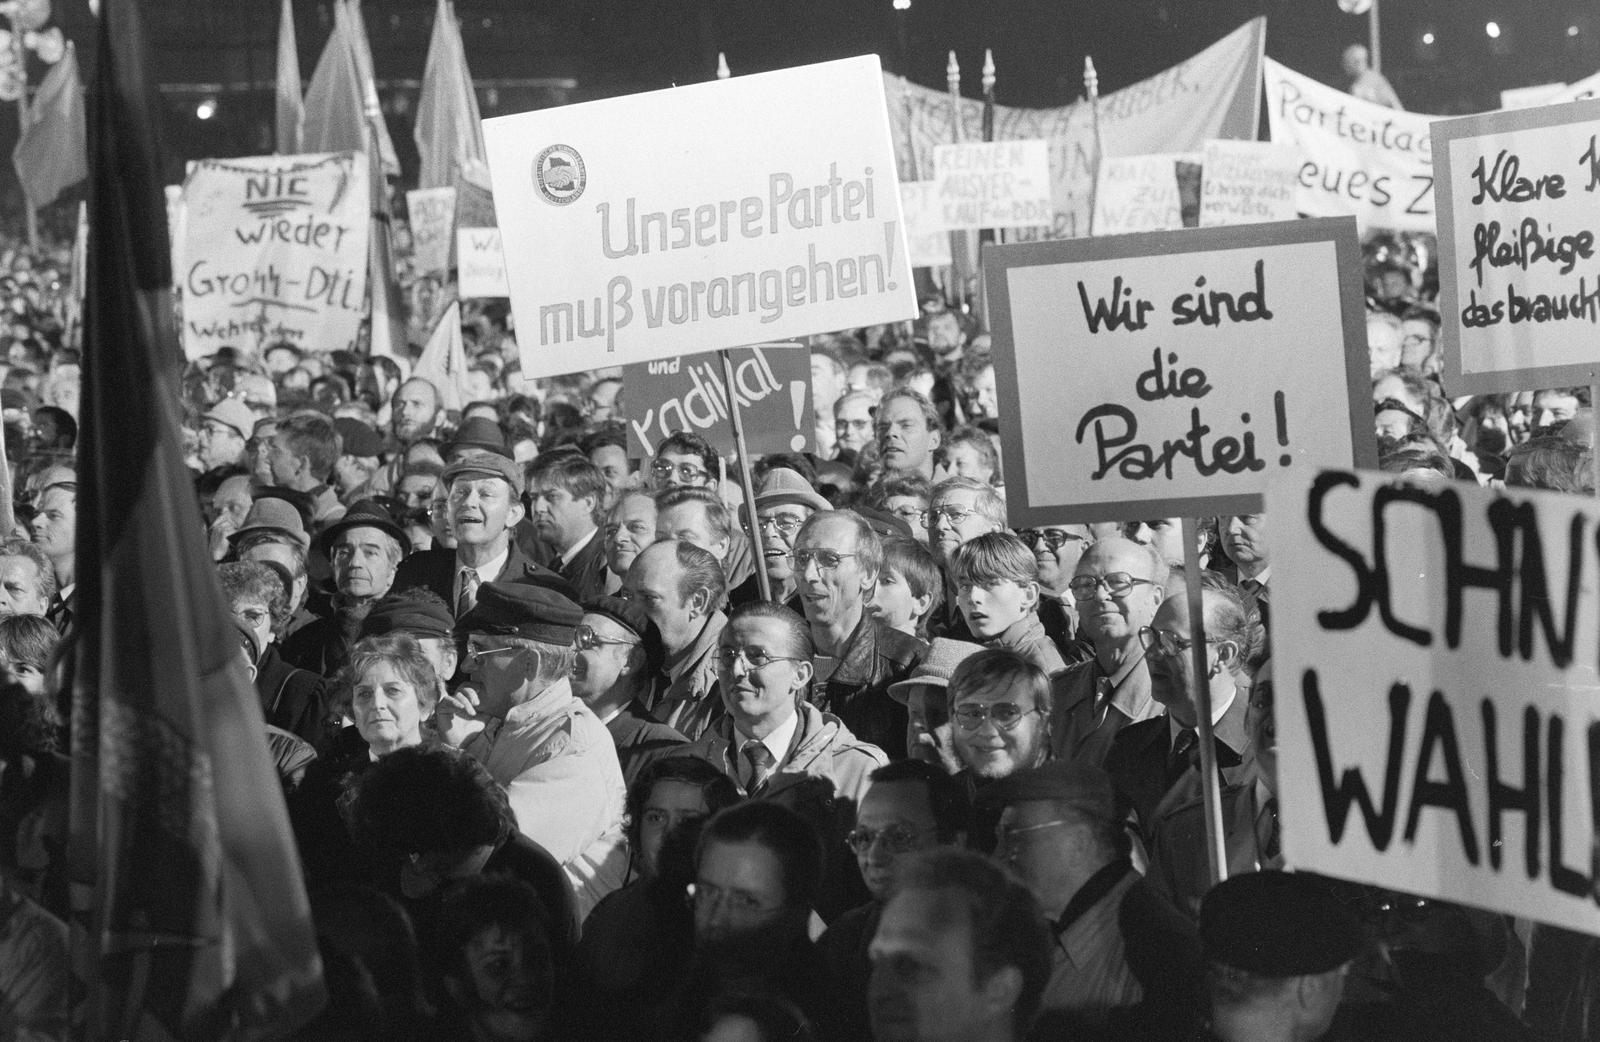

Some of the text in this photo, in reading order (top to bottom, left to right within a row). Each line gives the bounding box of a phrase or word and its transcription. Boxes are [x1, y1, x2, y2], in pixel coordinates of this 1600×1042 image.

[246, 168, 308, 199] NIE
[940, 146, 1024, 170] KEINEN
[1298, 162, 1391, 207] eues
[1472, 149, 1567, 205] Klare
[596, 161, 875, 259] Unsere Partei
[938, 172, 1032, 200] AUSVER-
[943, 200, 990, 224] KAUF
[1011, 197, 1050, 220] DDR
[1469, 217, 1595, 288] fleißige
[539, 221, 897, 352] muß vorangehen!
[1077, 258, 1273, 334] Wir sind
[1508, 273, 1600, 324] brauch
[648, 357, 680, 375] und
[1136, 347, 1213, 401] die
[1075, 390, 1293, 480] Partei!
[1307, 468, 1600, 669] SCHN
